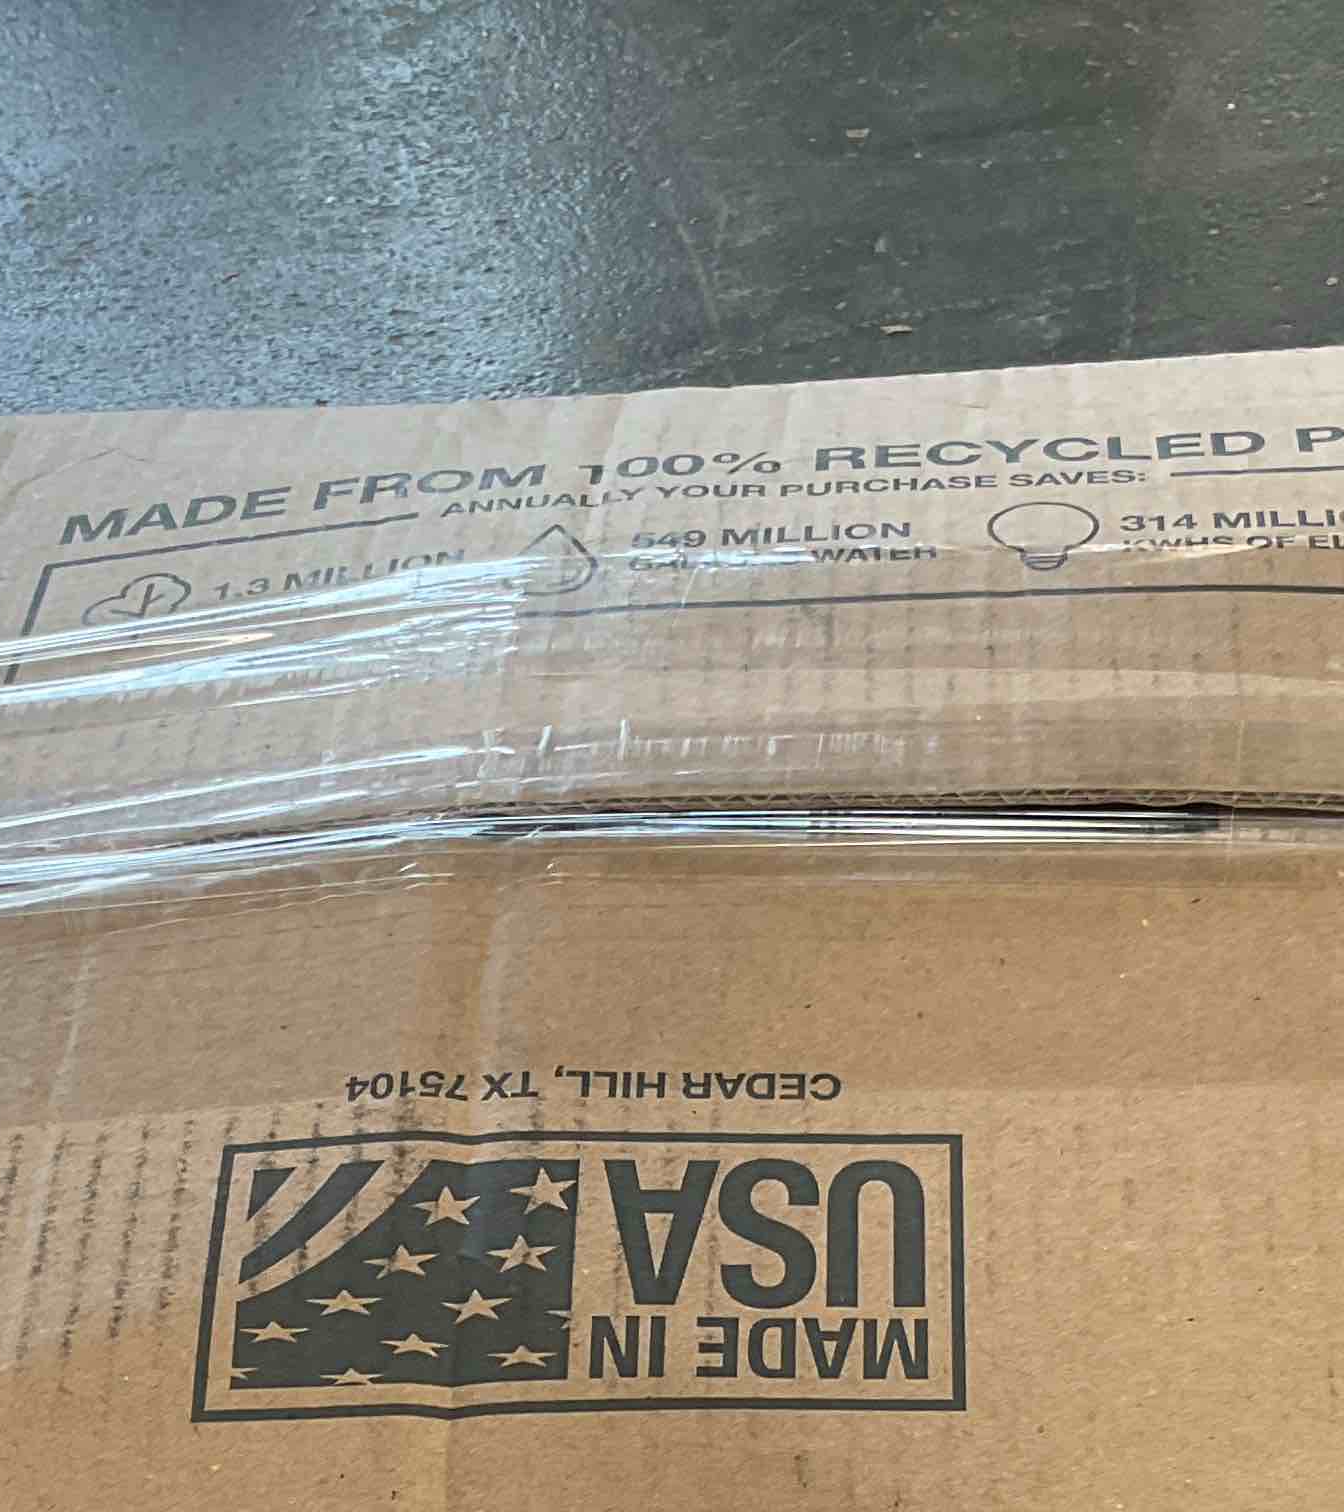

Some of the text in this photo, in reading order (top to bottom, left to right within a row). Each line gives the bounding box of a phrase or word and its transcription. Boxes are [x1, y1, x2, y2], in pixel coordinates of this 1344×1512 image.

[60, 487, 292, 545] MADE
[314, 465, 545, 510] FROM
[578, 452, 781, 484] 100%
[815, 431, 1265, 472] RECYCLED
[440, 469, 1146, 518] ANNUALLY YOUR PURCHASE SAVES:
[632, 522, 910, 548] 549 MILLION
[1120, 514, 1197, 531] 314
[213, 578, 270, 600] 1.3
[345, 1066, 842, 1102] CEDAR HILL, TX 75104
[604, 1159, 926, 1309] USA
[589, 1315, 930, 1380] MADE IN
